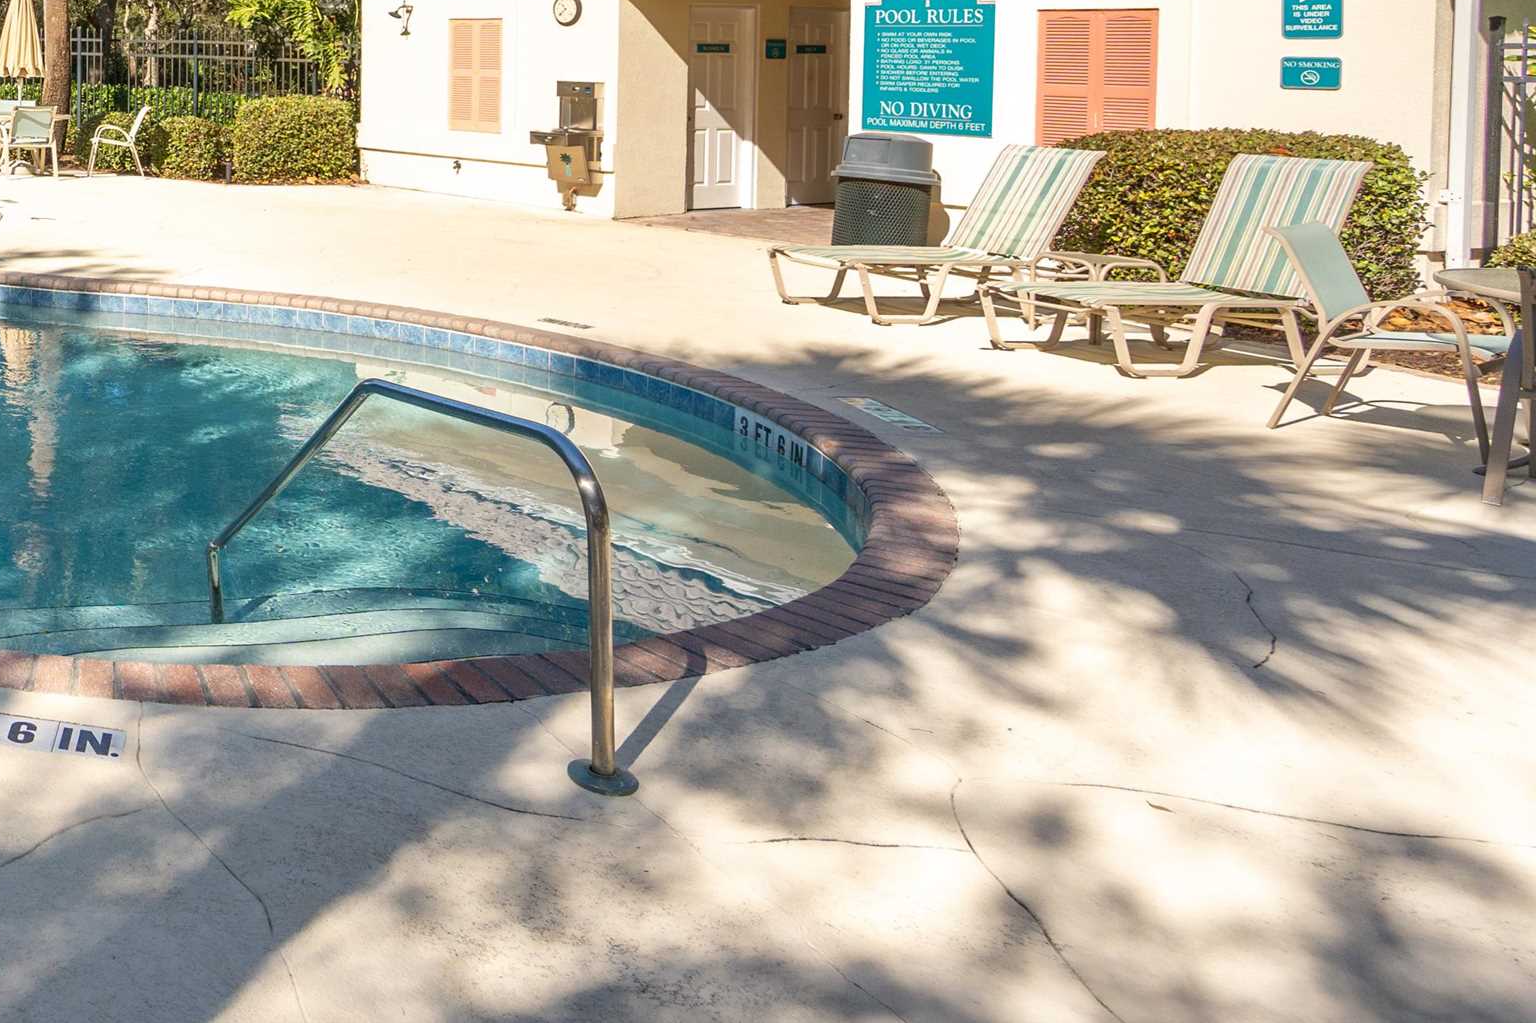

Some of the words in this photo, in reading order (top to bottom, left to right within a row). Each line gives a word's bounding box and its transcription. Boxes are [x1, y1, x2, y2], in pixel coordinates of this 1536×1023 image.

[875, 9, 921, 24] POOL
[927, 8, 984, 24] RULES
[880, 101, 904, 115] NO
[910, 102, 972, 119] DIVING
[867, 117, 887, 126] POOL
[889, 119, 928, 128] MAXIMUM
[930, 121, 956, 129] DEPTH
[965, 123, 985, 131] FEET
[739, 416, 748, 436] 3
[755, 422, 772, 447] FT
[777, 435, 786, 456] 6
[790, 440, 804, 466] IN
[7, 721, 38, 744] 6
[58, 727, 119, 758] IN.
